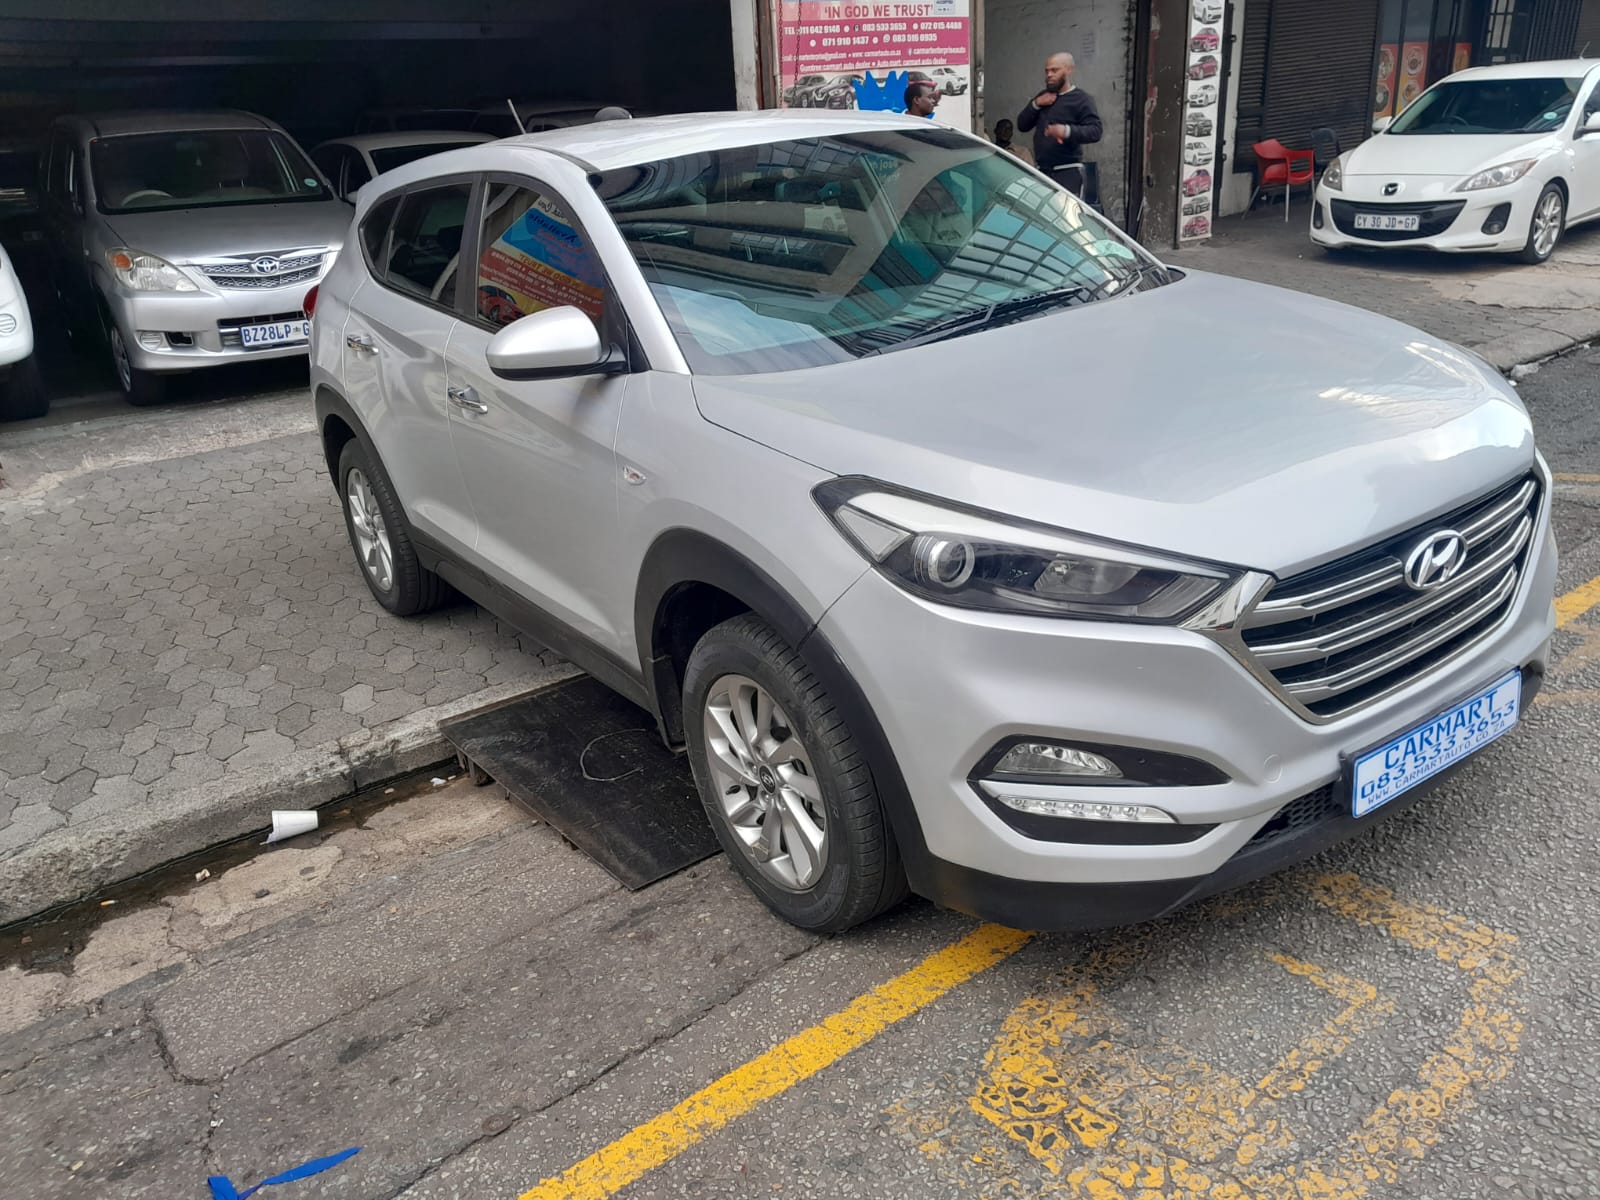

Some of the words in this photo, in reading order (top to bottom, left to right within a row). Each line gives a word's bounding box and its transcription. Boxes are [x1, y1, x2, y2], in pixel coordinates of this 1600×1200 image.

[844, 5, 869, 18] GOD
[873, 4, 890, 17] WE
[1356, 215, 1367, 227] CY
[243, 324, 292, 343] BZ28LP
[1384, 690, 1498, 770] CARMART
[1360, 762, 1407, 800] 083
[1413, 734, 1458, 770] 533
[1463, 699, 1516, 742] 3653
